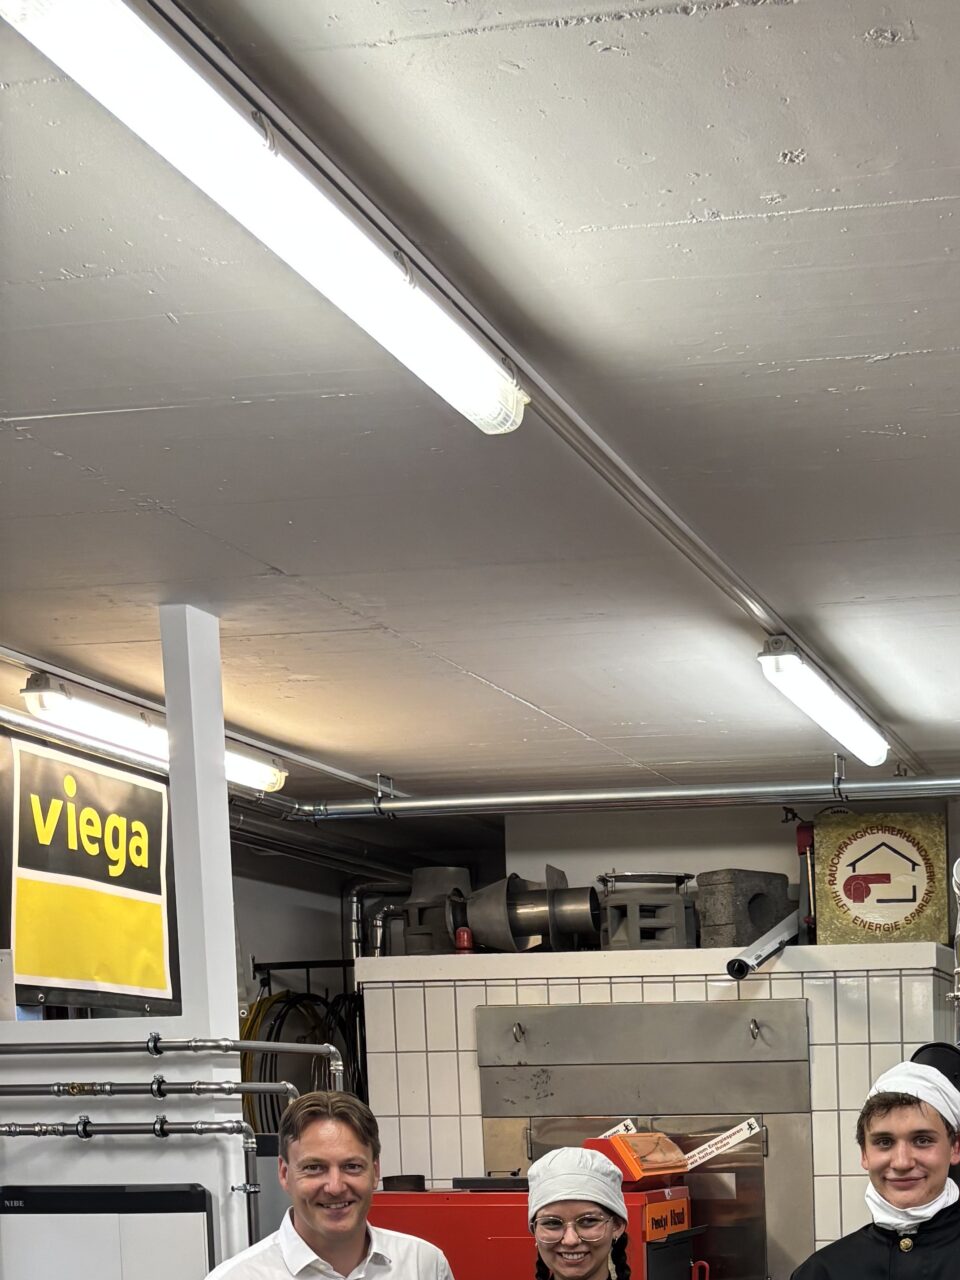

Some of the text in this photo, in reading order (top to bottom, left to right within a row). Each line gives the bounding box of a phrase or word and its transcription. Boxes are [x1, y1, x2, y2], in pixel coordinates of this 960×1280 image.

[30, 774, 149, 877] viega
[827, 825, 936, 887] RAUCHFANGKEHRERHANDWERK
[831, 890, 935, 932] HILFT ENERGIE SPAREN
